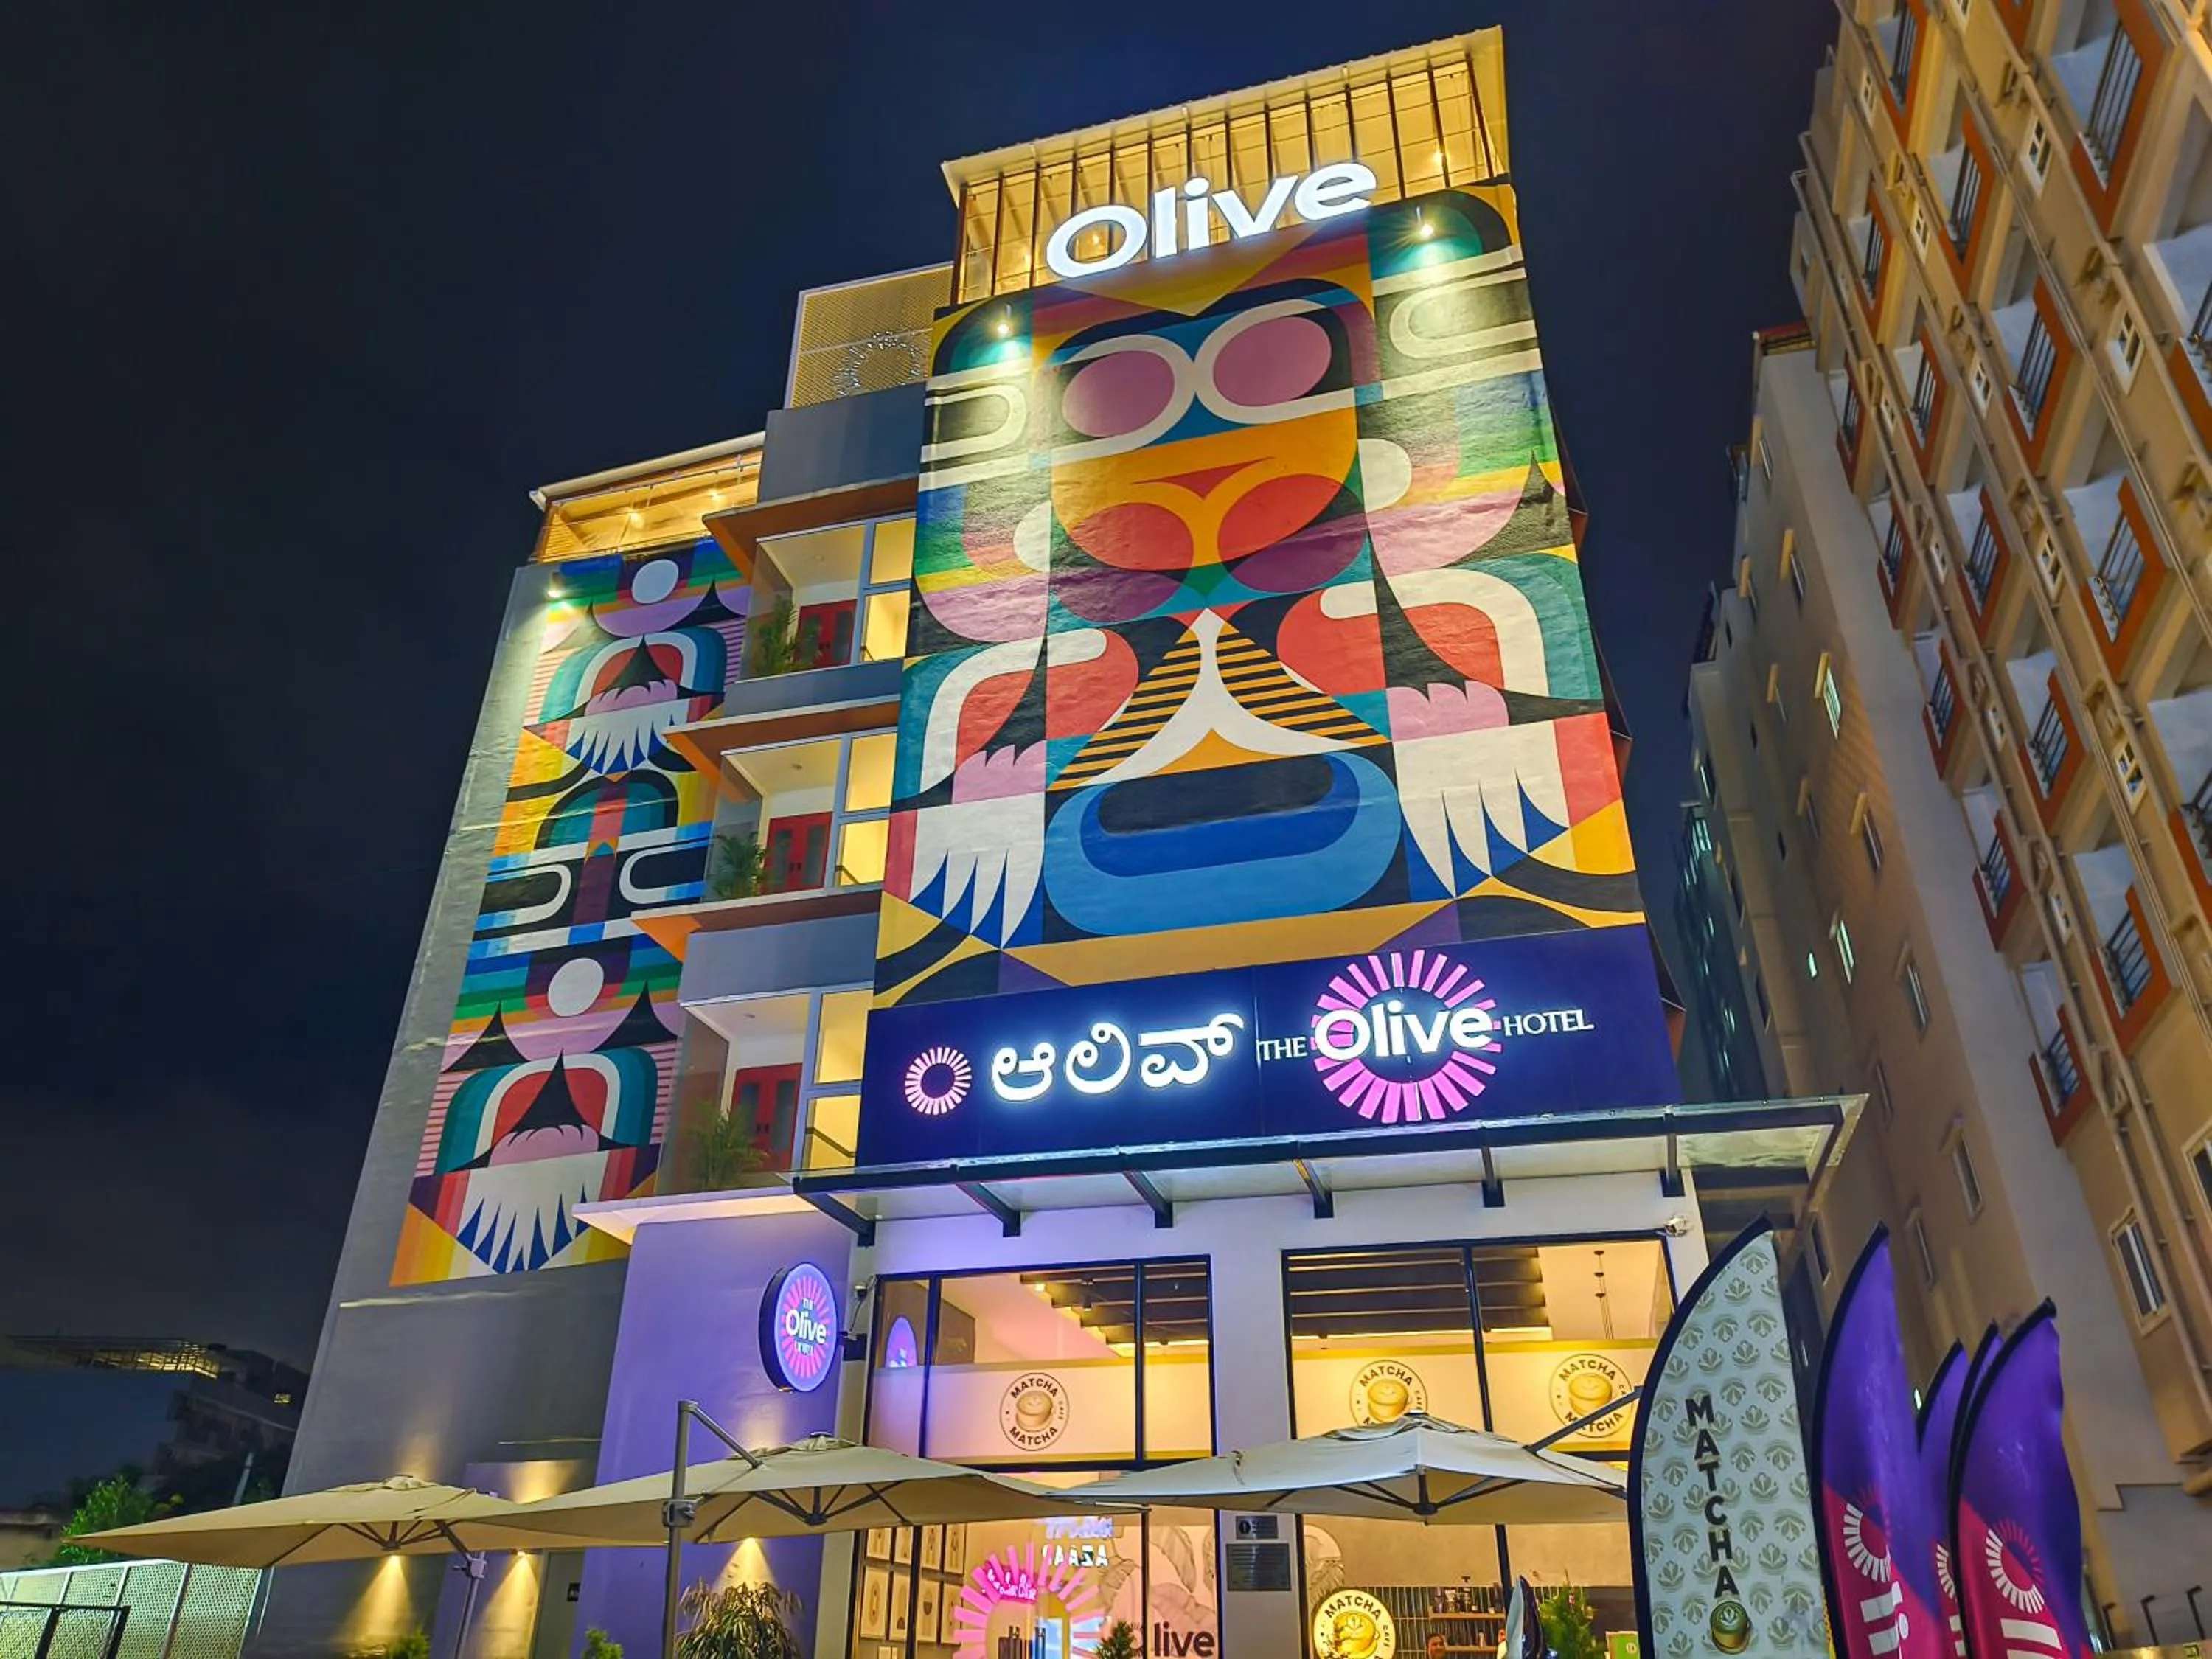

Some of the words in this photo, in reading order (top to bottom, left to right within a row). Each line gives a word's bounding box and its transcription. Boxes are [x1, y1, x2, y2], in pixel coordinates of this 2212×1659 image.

[1046, 162, 1377, 278] Olive
[1256, 1037, 1307, 1061] THE
[1315, 1000, 1495, 1061] Olive
[1503, 1009, 1594, 1036] HOTEL
[992, 1012, 1244, 1102] ಆಲಿವ್
[786, 1309, 826, 1344] Olive
[1360, 1366, 1412, 1385] MATCHA
[1559, 1359, 1615, 1380] MATCHA
[1011, 1378, 1058, 1399] MATCHA
[1565, 1411, 1624, 1432] MTCHA
[1010, 1427, 1058, 1445] MATCHA
[1685, 1394, 1740, 1599] MATCHA
[1325, 1596, 1381, 1621] MATCHA
